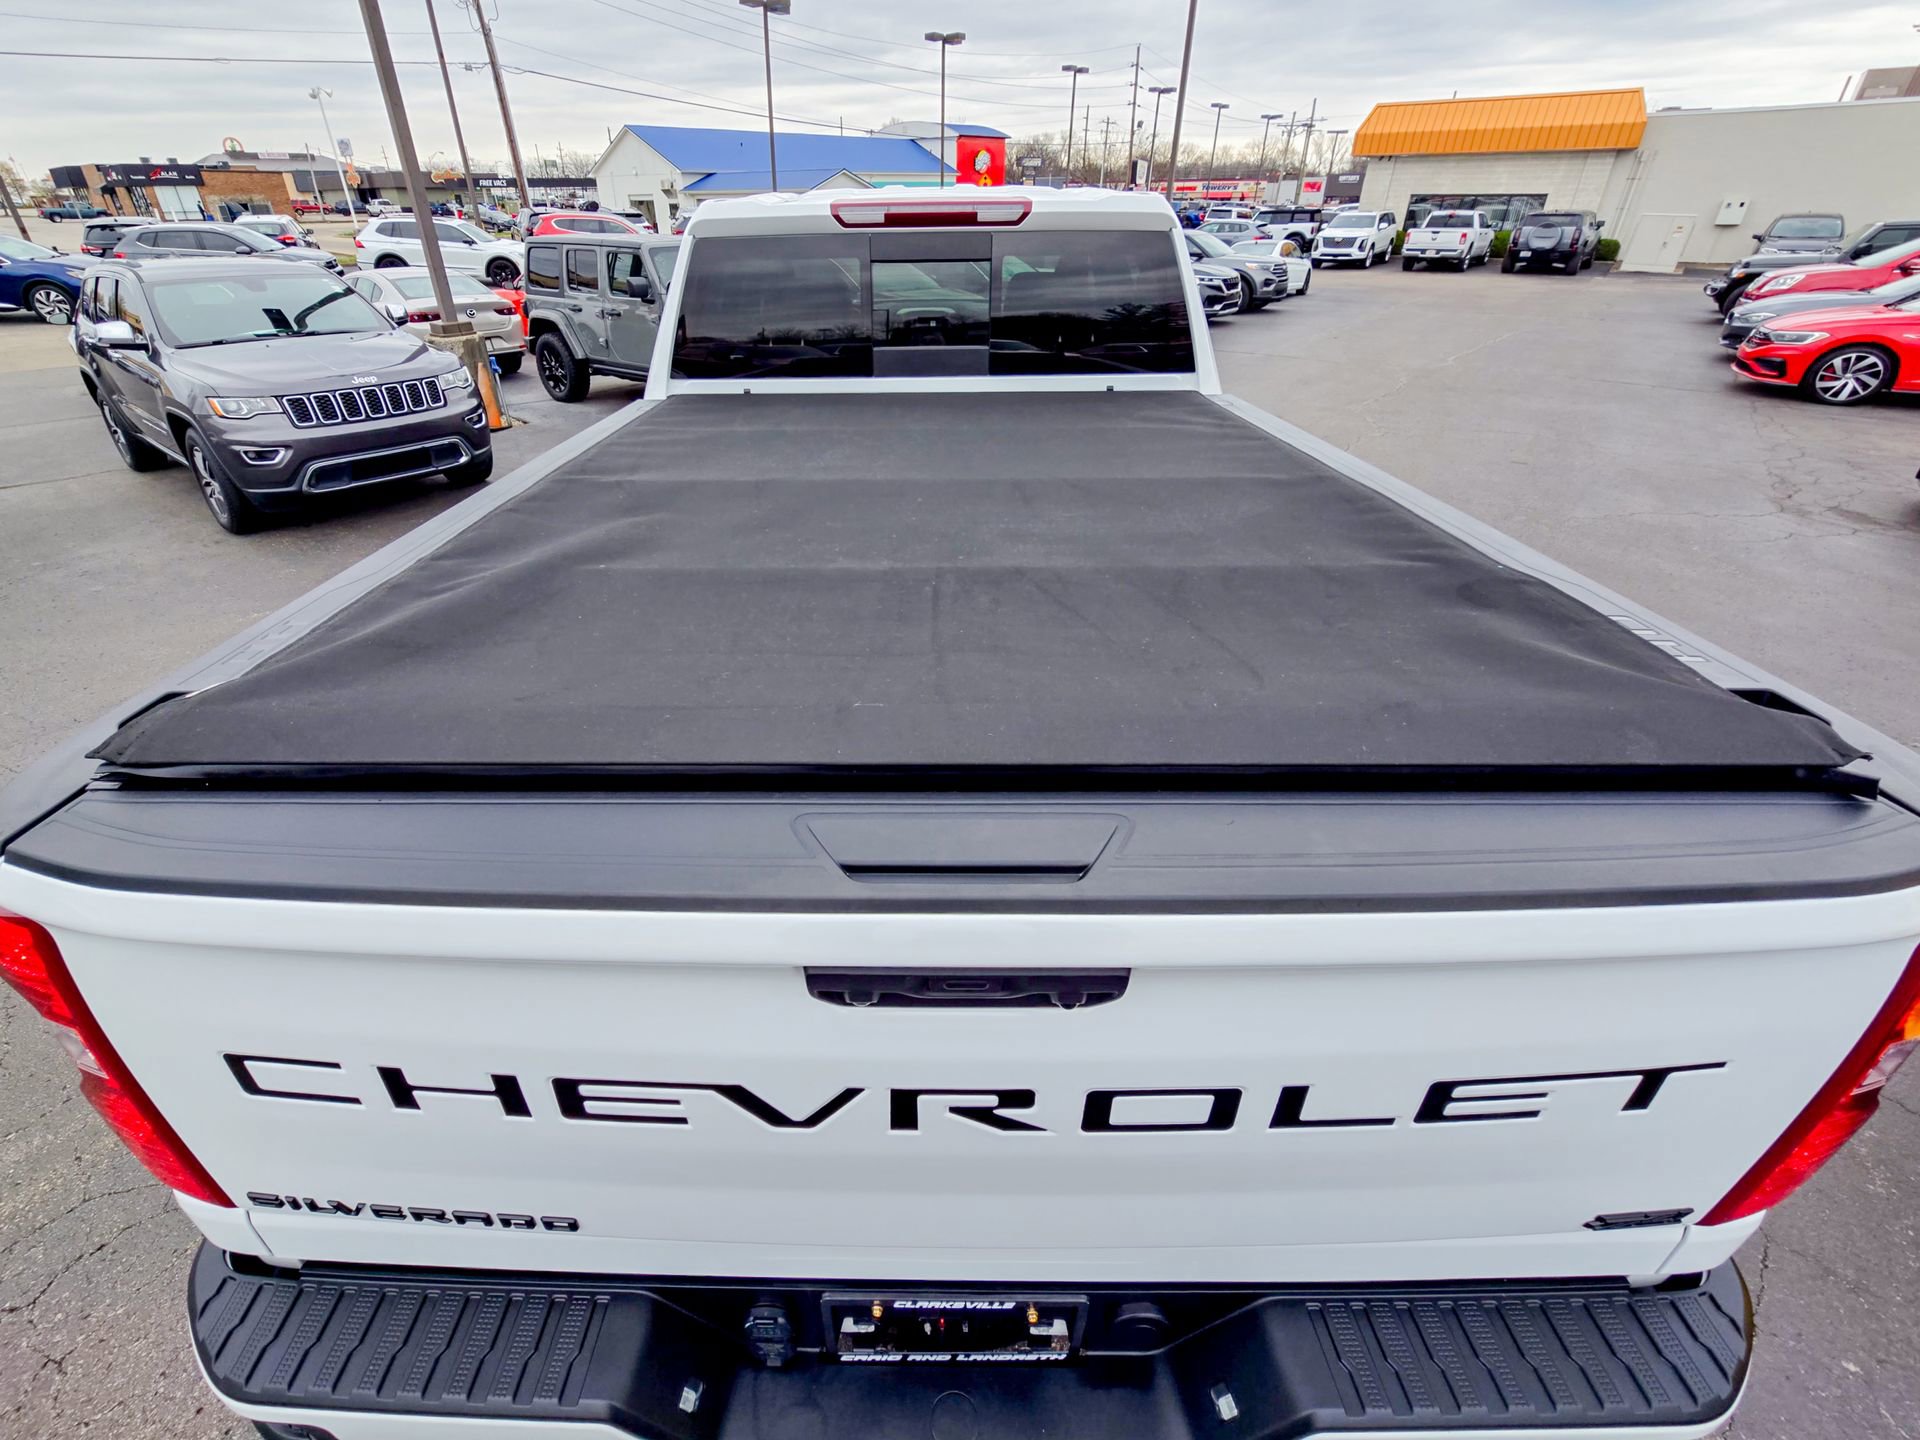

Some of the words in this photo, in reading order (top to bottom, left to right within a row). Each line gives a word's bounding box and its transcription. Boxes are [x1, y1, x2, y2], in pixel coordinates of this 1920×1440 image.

[479, 179, 493, 187] FREE
[493, 179, 507, 187] VACS
[352, 376, 378, 384] Jeep
[221, 1052, 1727, 1133] CHEVROLET
[246, 1190, 580, 1233] SILVERADO
[893, 1300, 1017, 1310] CLARKSVILLE
[907, 1353, 951, 1362] AND
